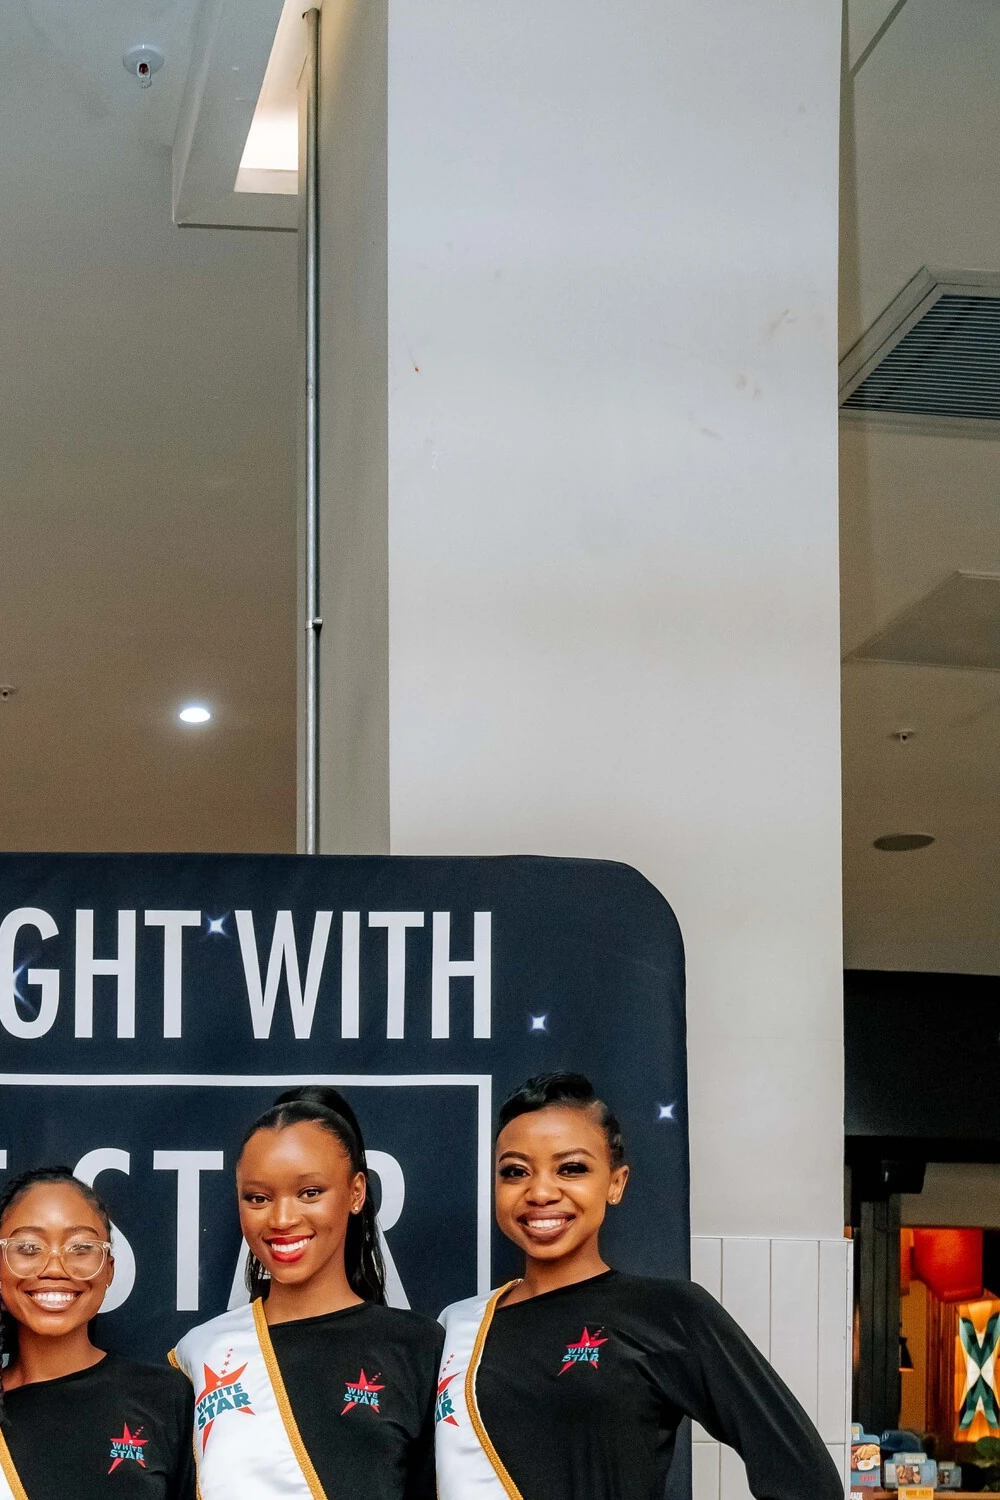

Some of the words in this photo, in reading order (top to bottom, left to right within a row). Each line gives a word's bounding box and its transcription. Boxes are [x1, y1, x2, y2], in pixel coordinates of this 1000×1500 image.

[234, 909, 493, 1040] WITH
[561, 1352, 600, 1362] STAR
[196, 1382, 244, 1414] WHITE
[343, 1393, 380, 1407] STAR
[197, 1392, 253, 1431] STAR
[110, 1449, 145, 1460] STAR
